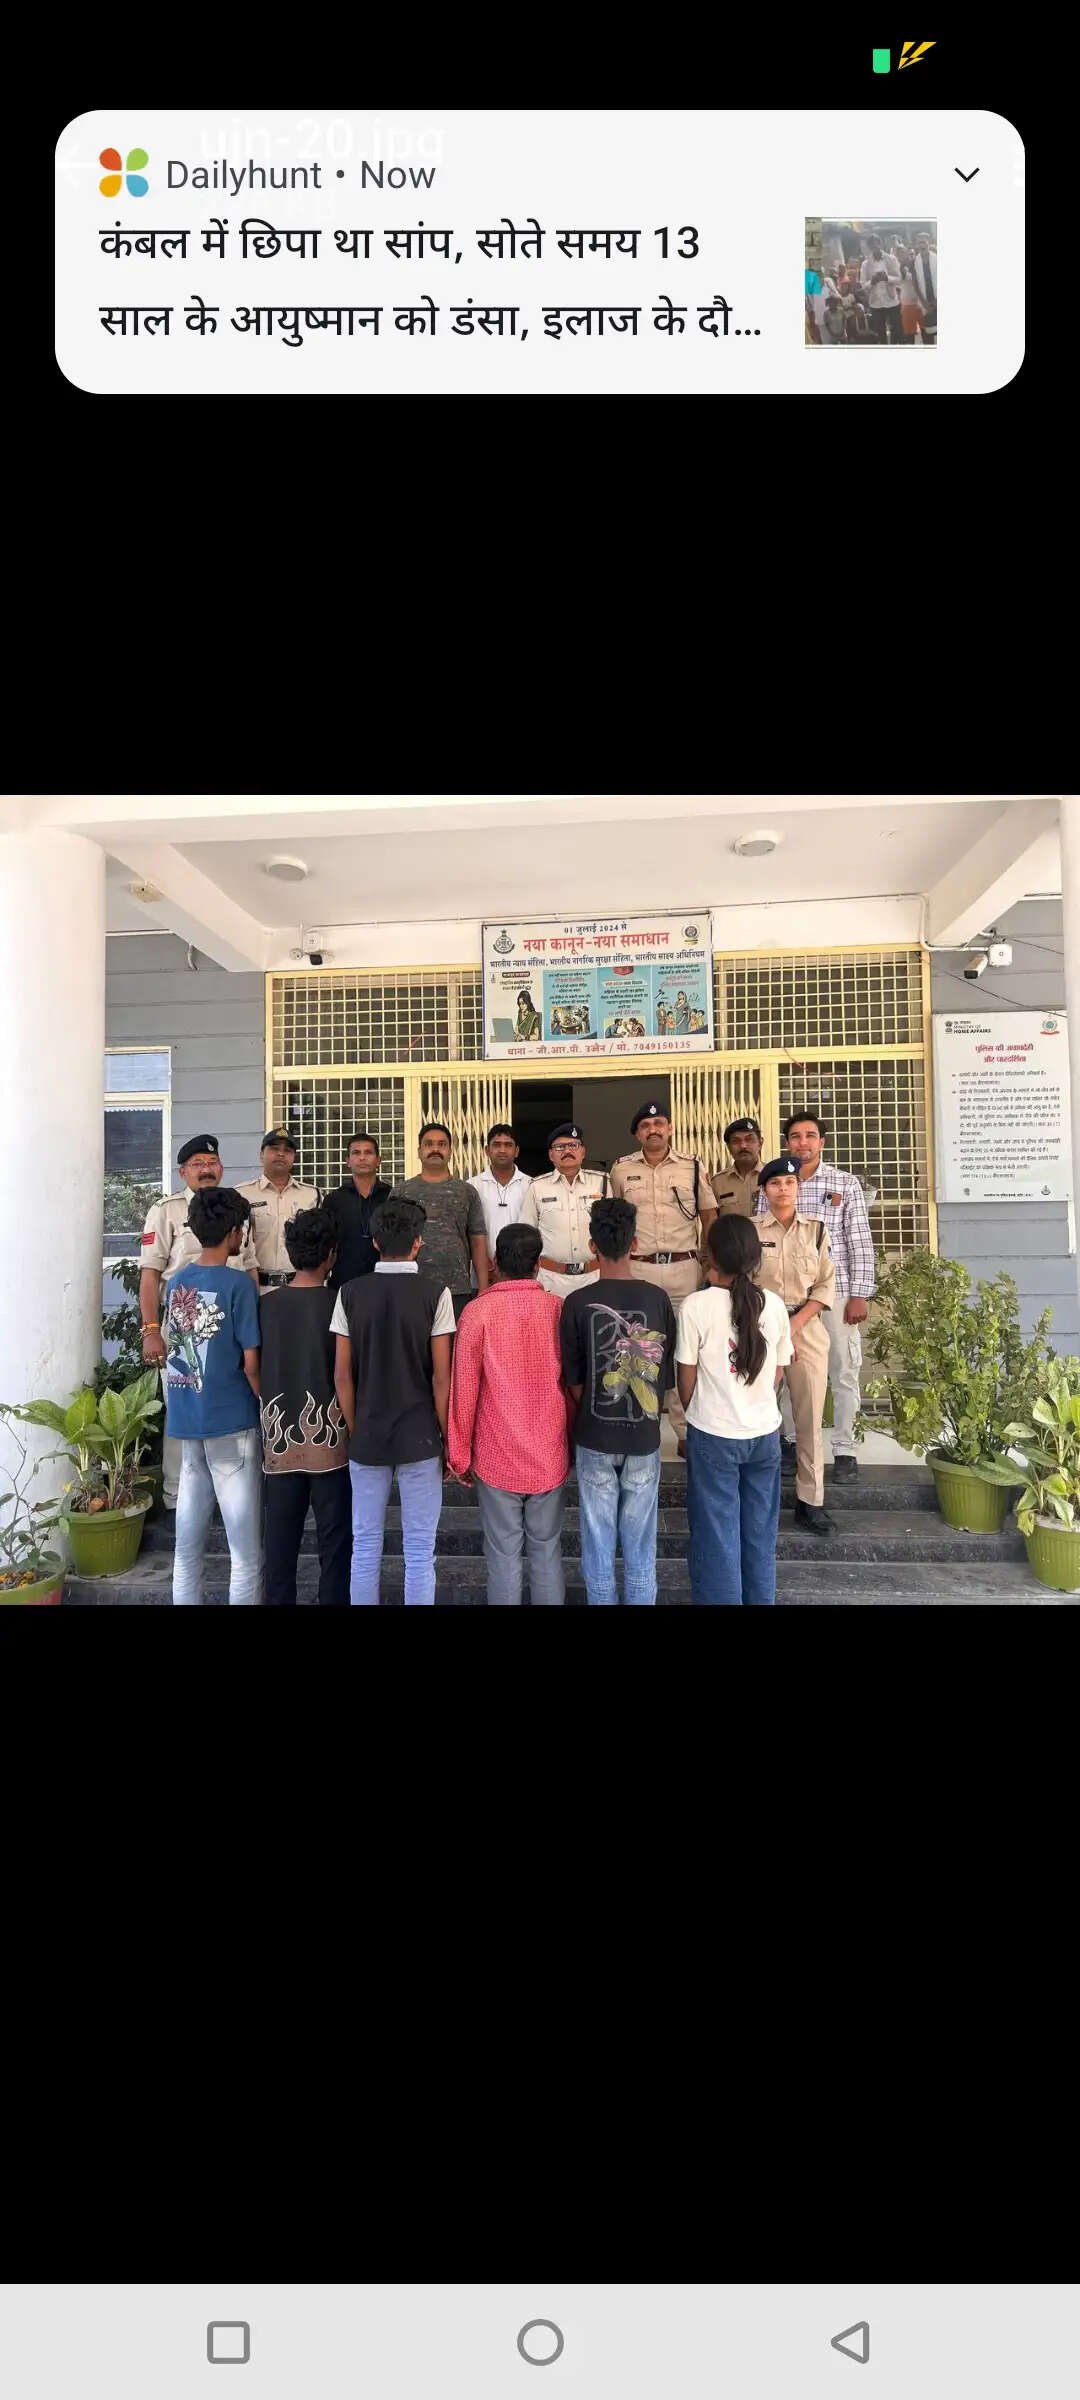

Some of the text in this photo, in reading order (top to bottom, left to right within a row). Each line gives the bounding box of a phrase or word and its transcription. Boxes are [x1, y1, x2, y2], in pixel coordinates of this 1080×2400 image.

[576, 923, 598, 935] जुलाई
[599, 924, 619, 932] 2024
[523, 939, 547, 952] नया
[620, 932, 670, 947] समाधान
[490, 958, 511, 968] भारतीय
[512, 959, 526, 968] न्याय
[550, 956, 571, 966] भारतीय
[572, 955, 594, 965] नागरिक
[595, 955, 611, 967] सुरक्षा
[635, 952, 656, 962] भारतीय
[676, 949, 705, 959] अधिनियम
[507, 1047, 526, 1055] थाना
[633, 1040, 691, 1051] 7049150135
